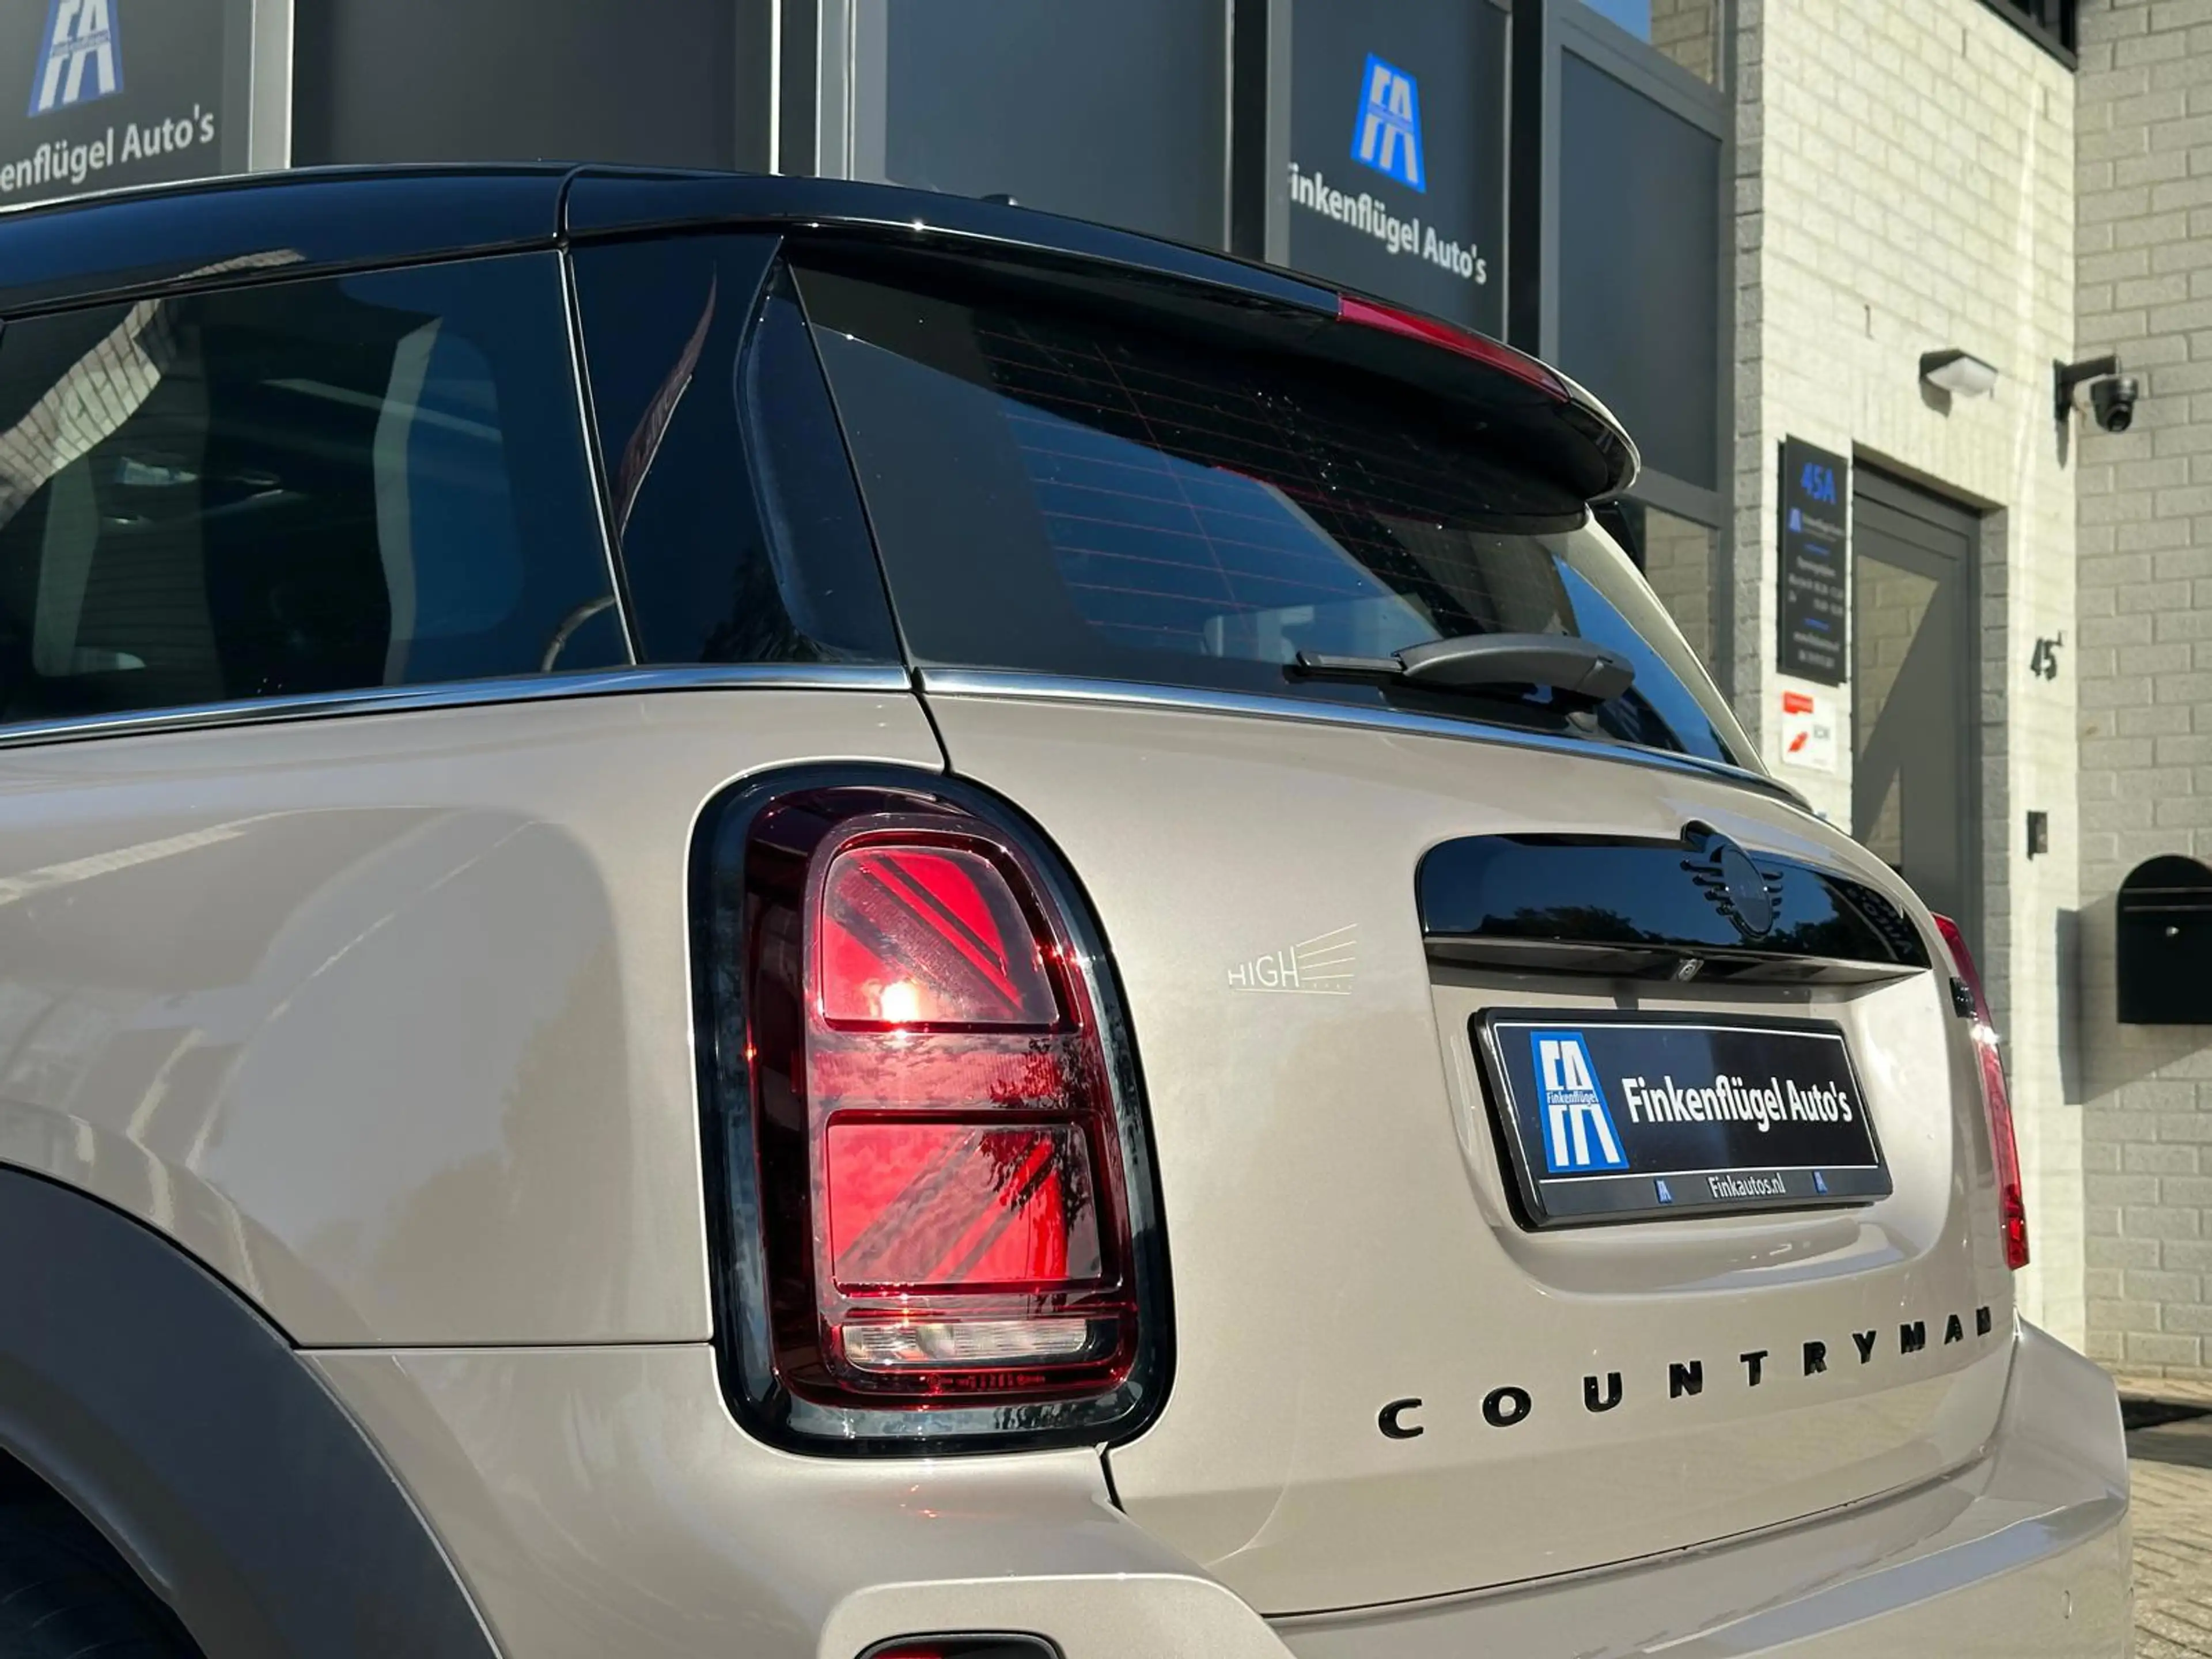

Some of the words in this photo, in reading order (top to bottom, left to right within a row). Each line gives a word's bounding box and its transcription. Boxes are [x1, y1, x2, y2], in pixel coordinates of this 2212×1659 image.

[0, 127, 114, 191] enflügel
[120, 103, 215, 163] Auto's
[1422, 226, 1487, 285] Auto's
[1800, 461, 1837, 505] 45A
[2031, 630, 2064, 681] 45
[1227, 945, 1300, 987] HIGH
[1622, 1074, 1787, 1132] Finkenflügel
[1786, 1079, 1853, 1123] Auto's
[1707, 1172, 1786, 1199] Finkautos.nl
[1377, 1305, 1994, 1440] COUNTRYMAN
